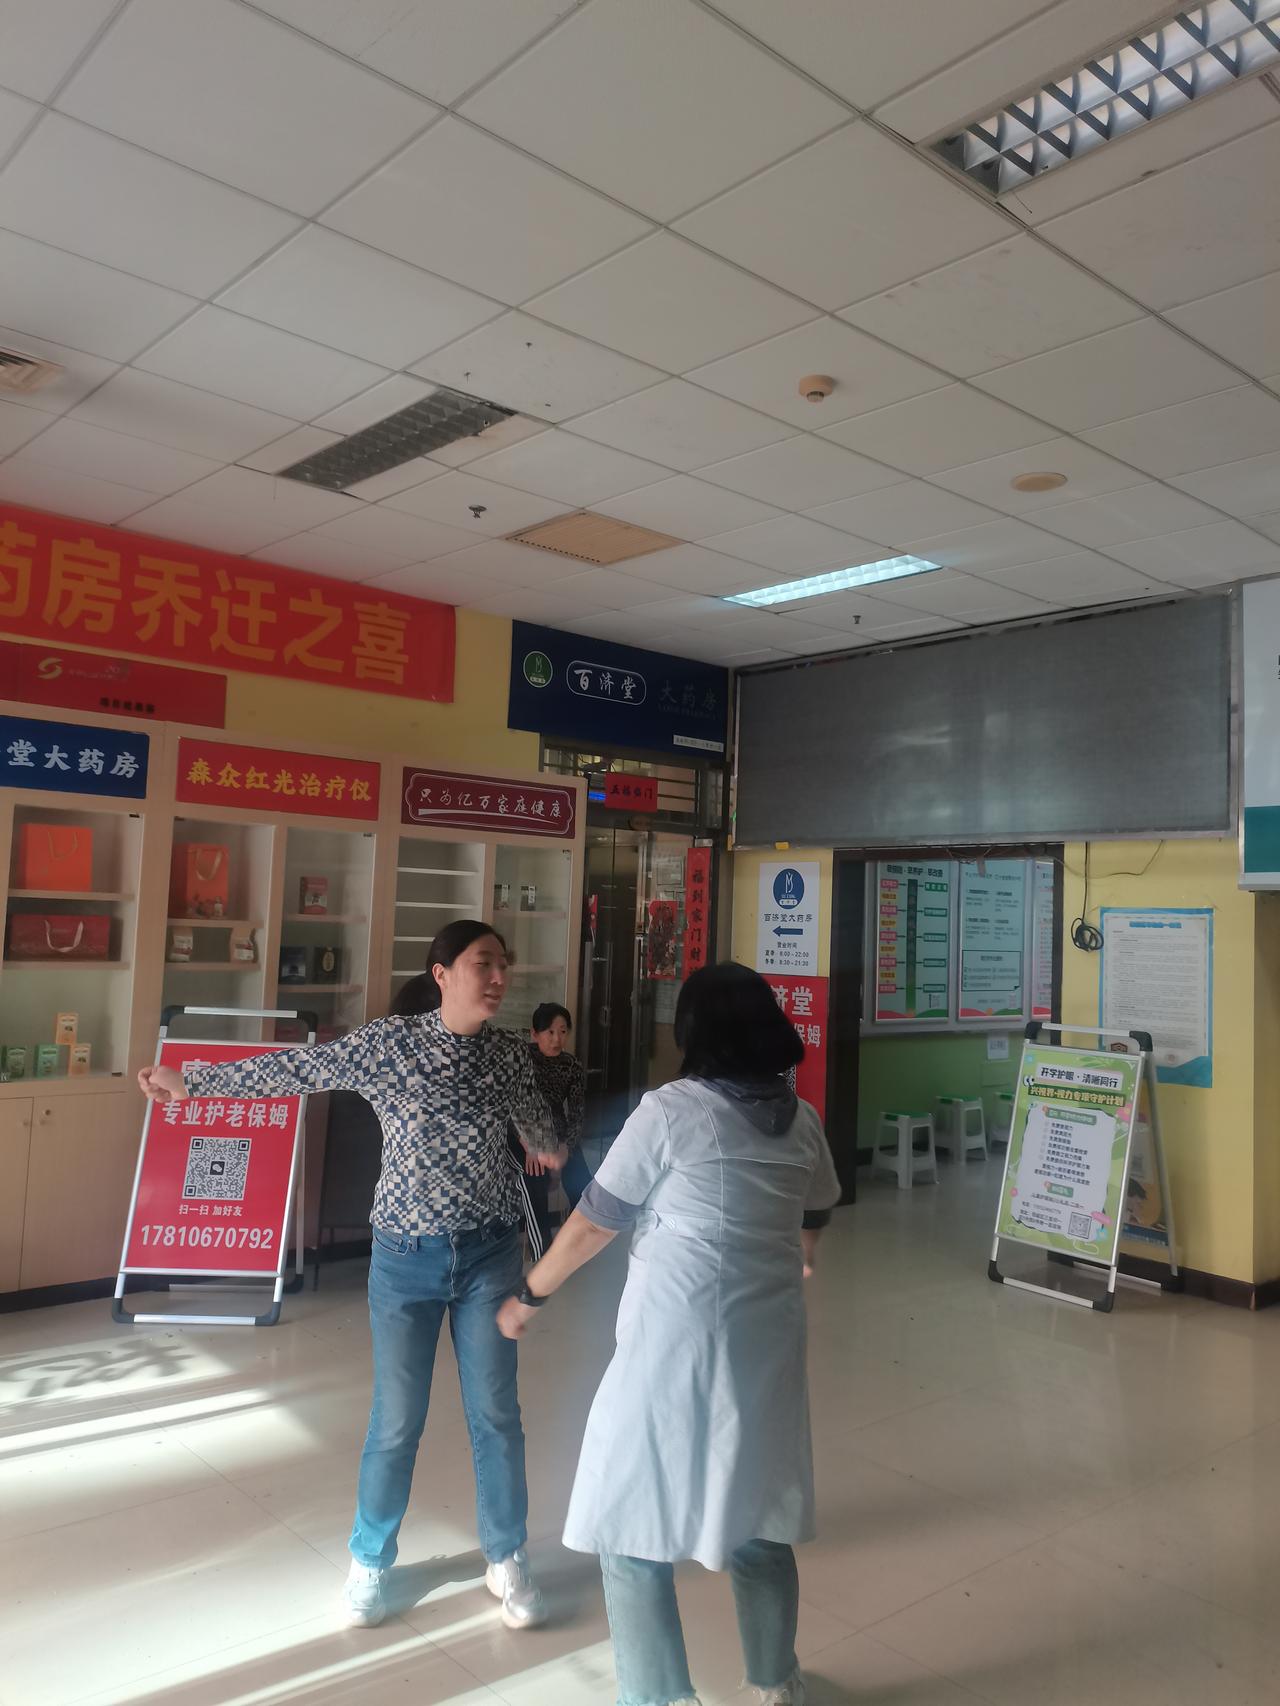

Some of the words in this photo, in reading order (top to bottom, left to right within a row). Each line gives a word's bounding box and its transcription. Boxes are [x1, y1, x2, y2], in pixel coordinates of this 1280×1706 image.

[574, 668, 637, 700] 百济堂
[7, 739, 140, 779] 堂大药房
[186, 758, 372, 801] 森众红光治疗仪
[610, 784, 653, 801] 五福临门
[420, 788, 562, 818] 只为亿万家庭健康
[689, 869, 705, 979] 福到家门财
[763, 912, 813, 923] 百济堂大药房
[162, 1100, 289, 1129] 专业护老保姆
[179, 1204, 209, 1215] 扫一扫
[212, 1204, 243, 1217] 加好友
[141, 1224, 274, 1249] 17810670792
